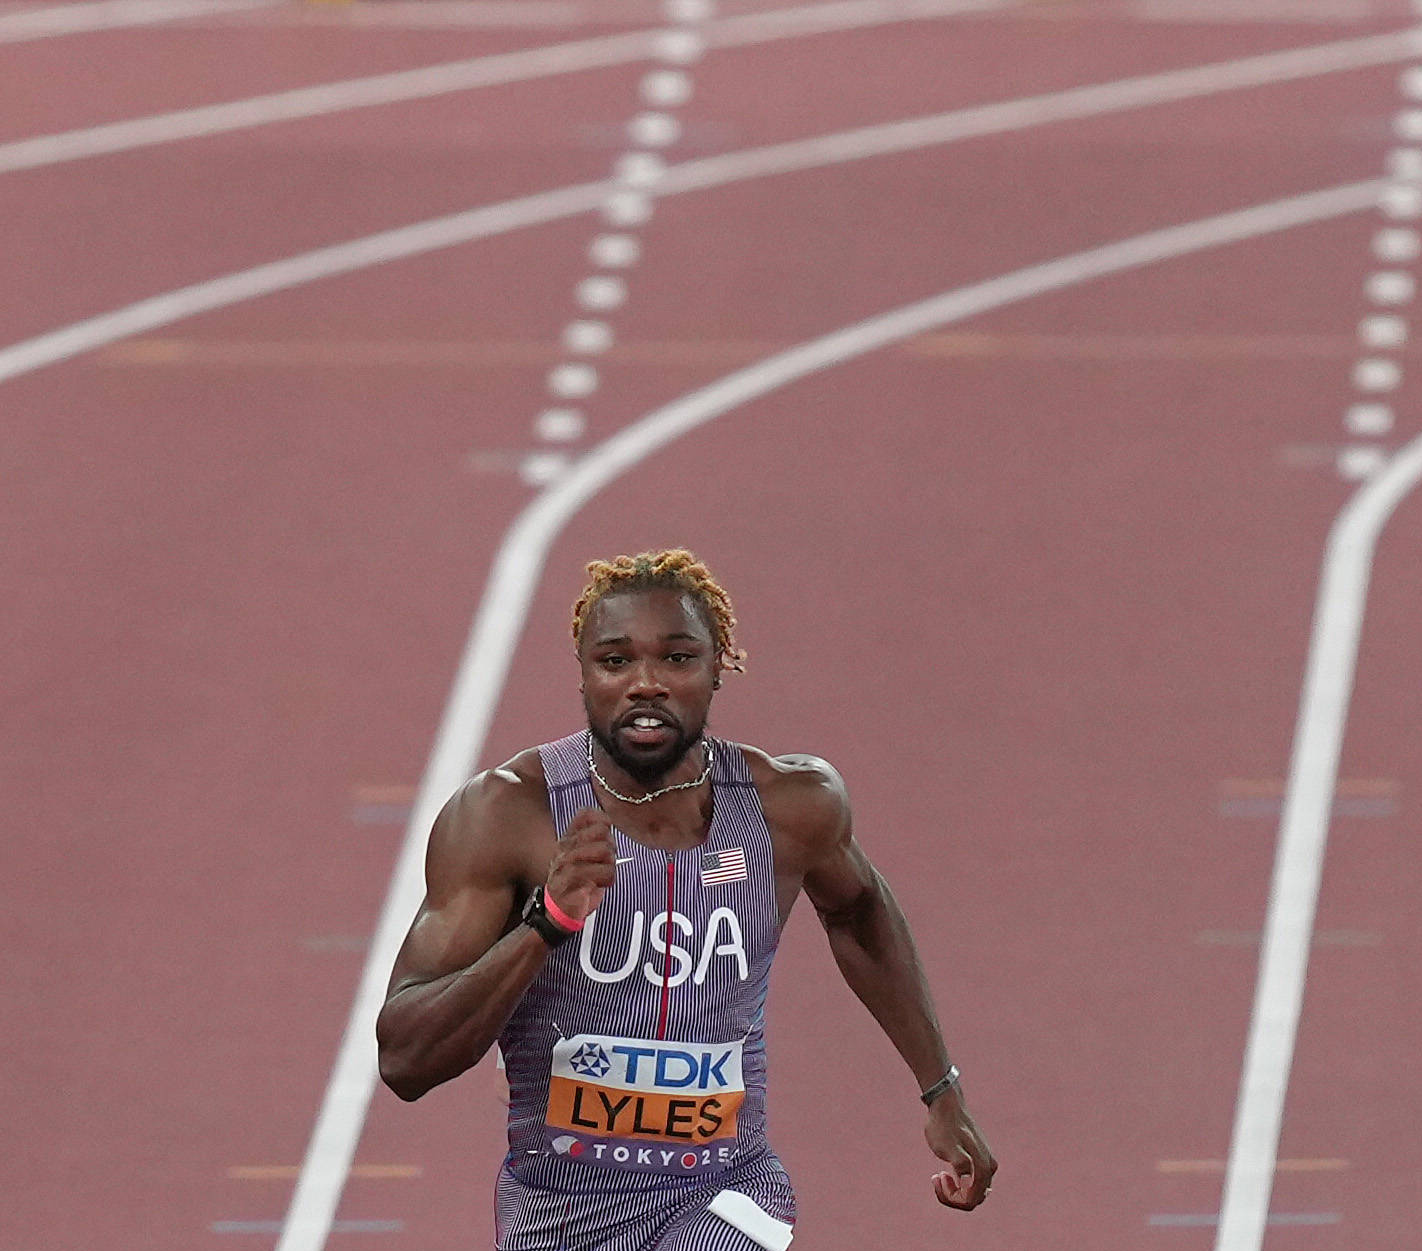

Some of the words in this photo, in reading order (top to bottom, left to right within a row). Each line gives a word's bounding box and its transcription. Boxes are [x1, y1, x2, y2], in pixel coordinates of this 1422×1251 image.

[579, 906, 748, 988] USA
[612, 1045, 733, 1089] TDK
[570, 1086, 723, 1138] LYLES
